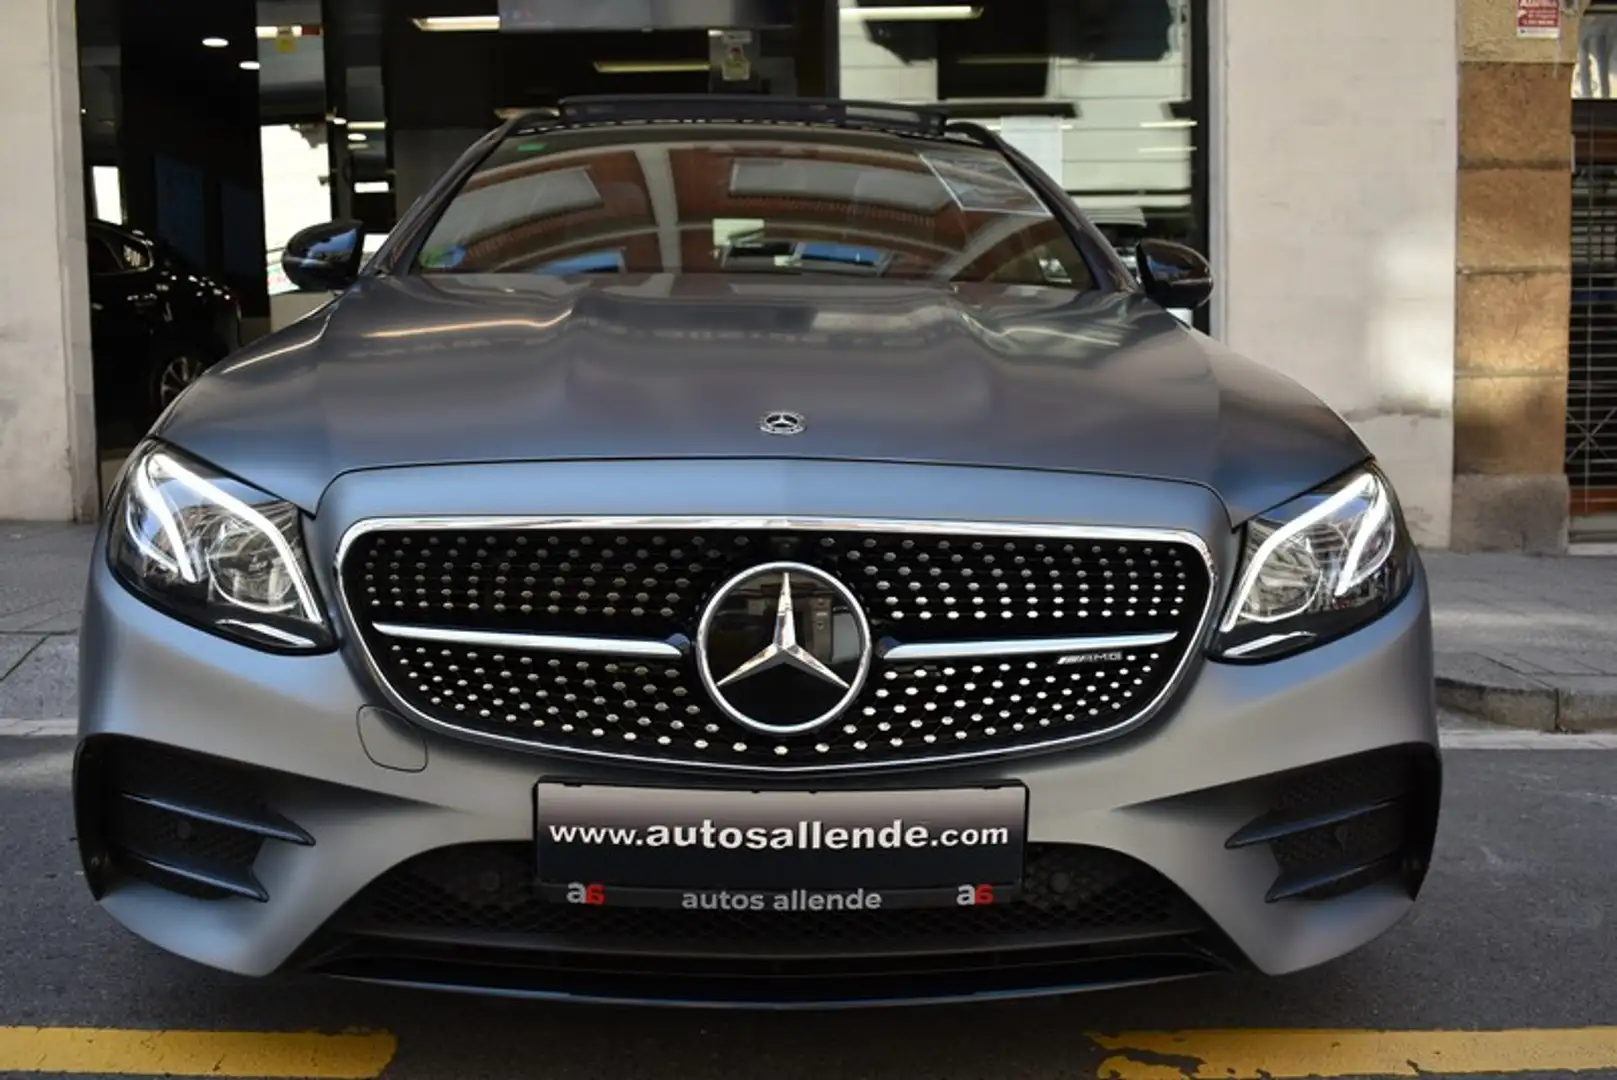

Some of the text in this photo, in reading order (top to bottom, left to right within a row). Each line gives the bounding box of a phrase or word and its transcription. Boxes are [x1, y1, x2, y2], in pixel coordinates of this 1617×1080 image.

[548, 819, 1009, 850] www.autosallende.com
[681, 888, 882, 911] autos allende
